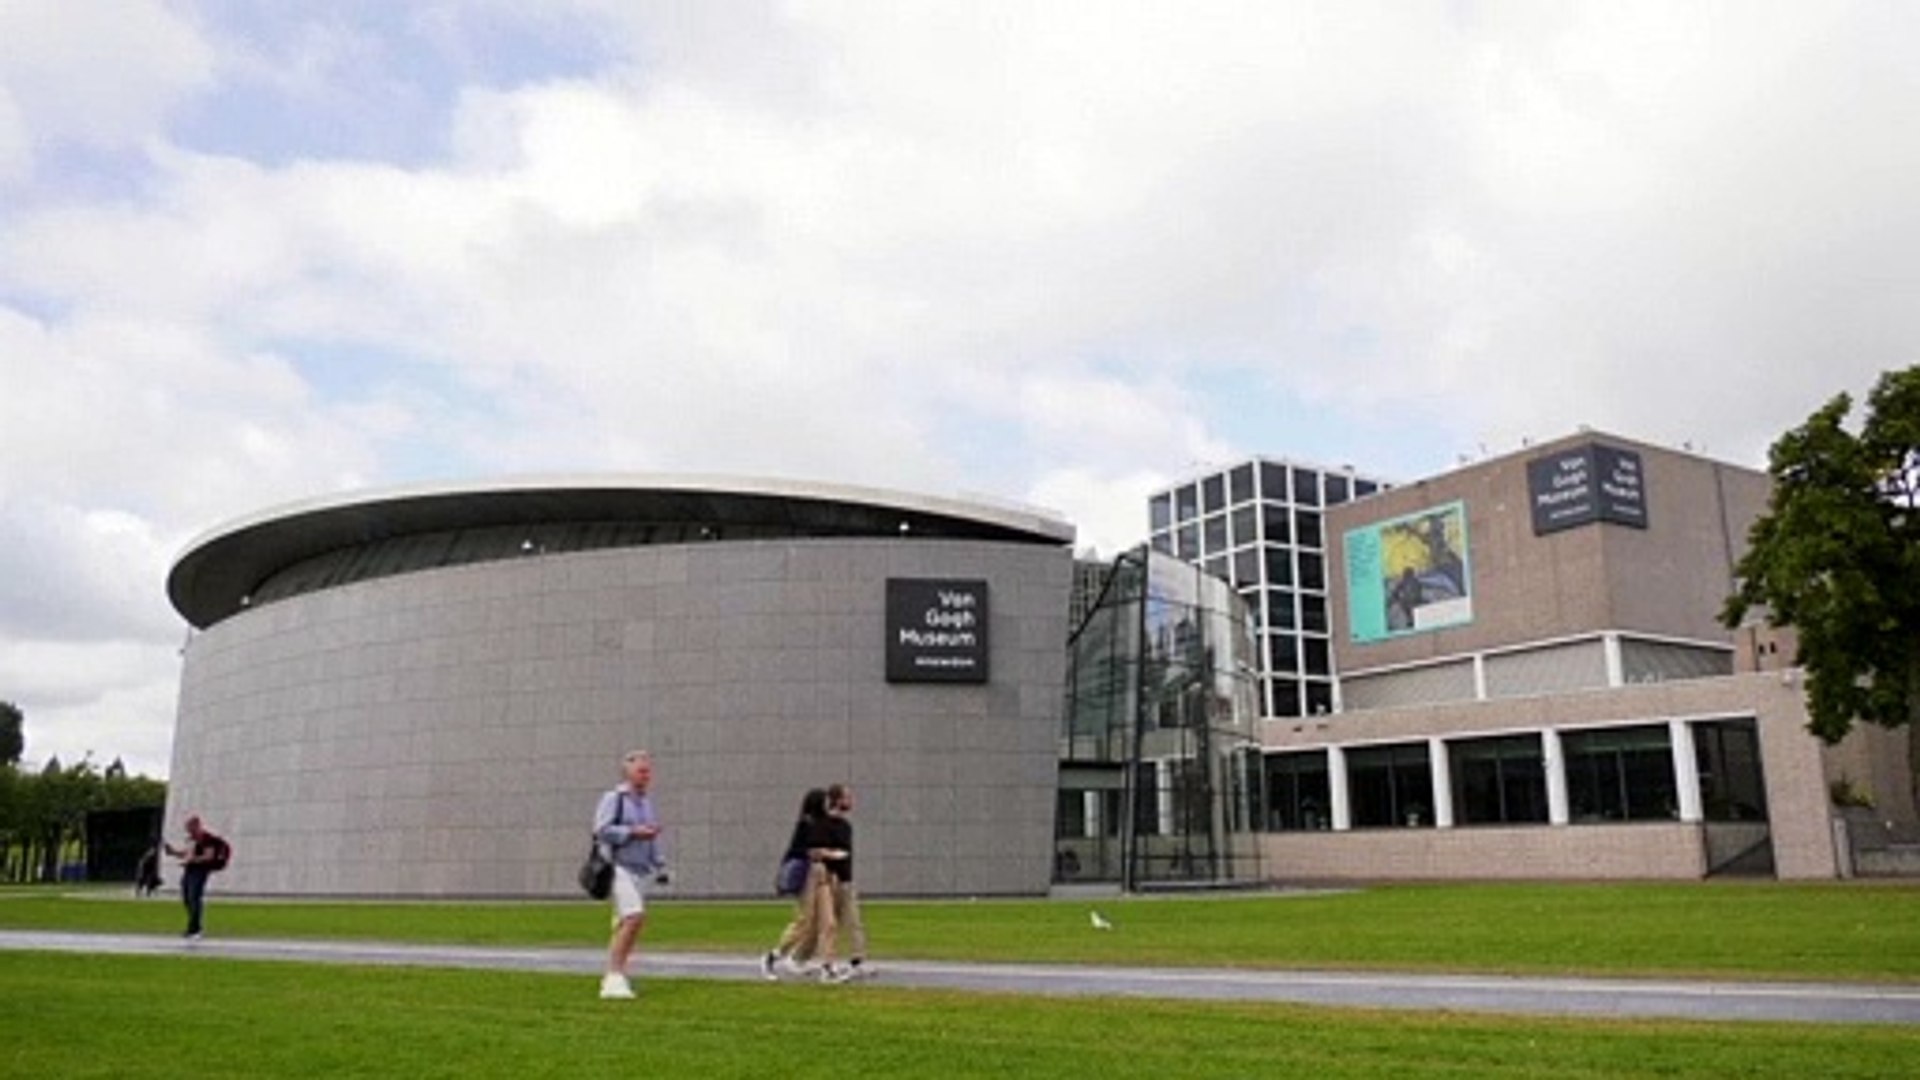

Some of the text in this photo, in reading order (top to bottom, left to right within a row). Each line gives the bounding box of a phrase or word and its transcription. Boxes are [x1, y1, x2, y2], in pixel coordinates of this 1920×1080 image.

[937, 590, 976, 608] Van
[925, 607, 976, 629] Gogh
[899, 628, 976, 646] Museum
